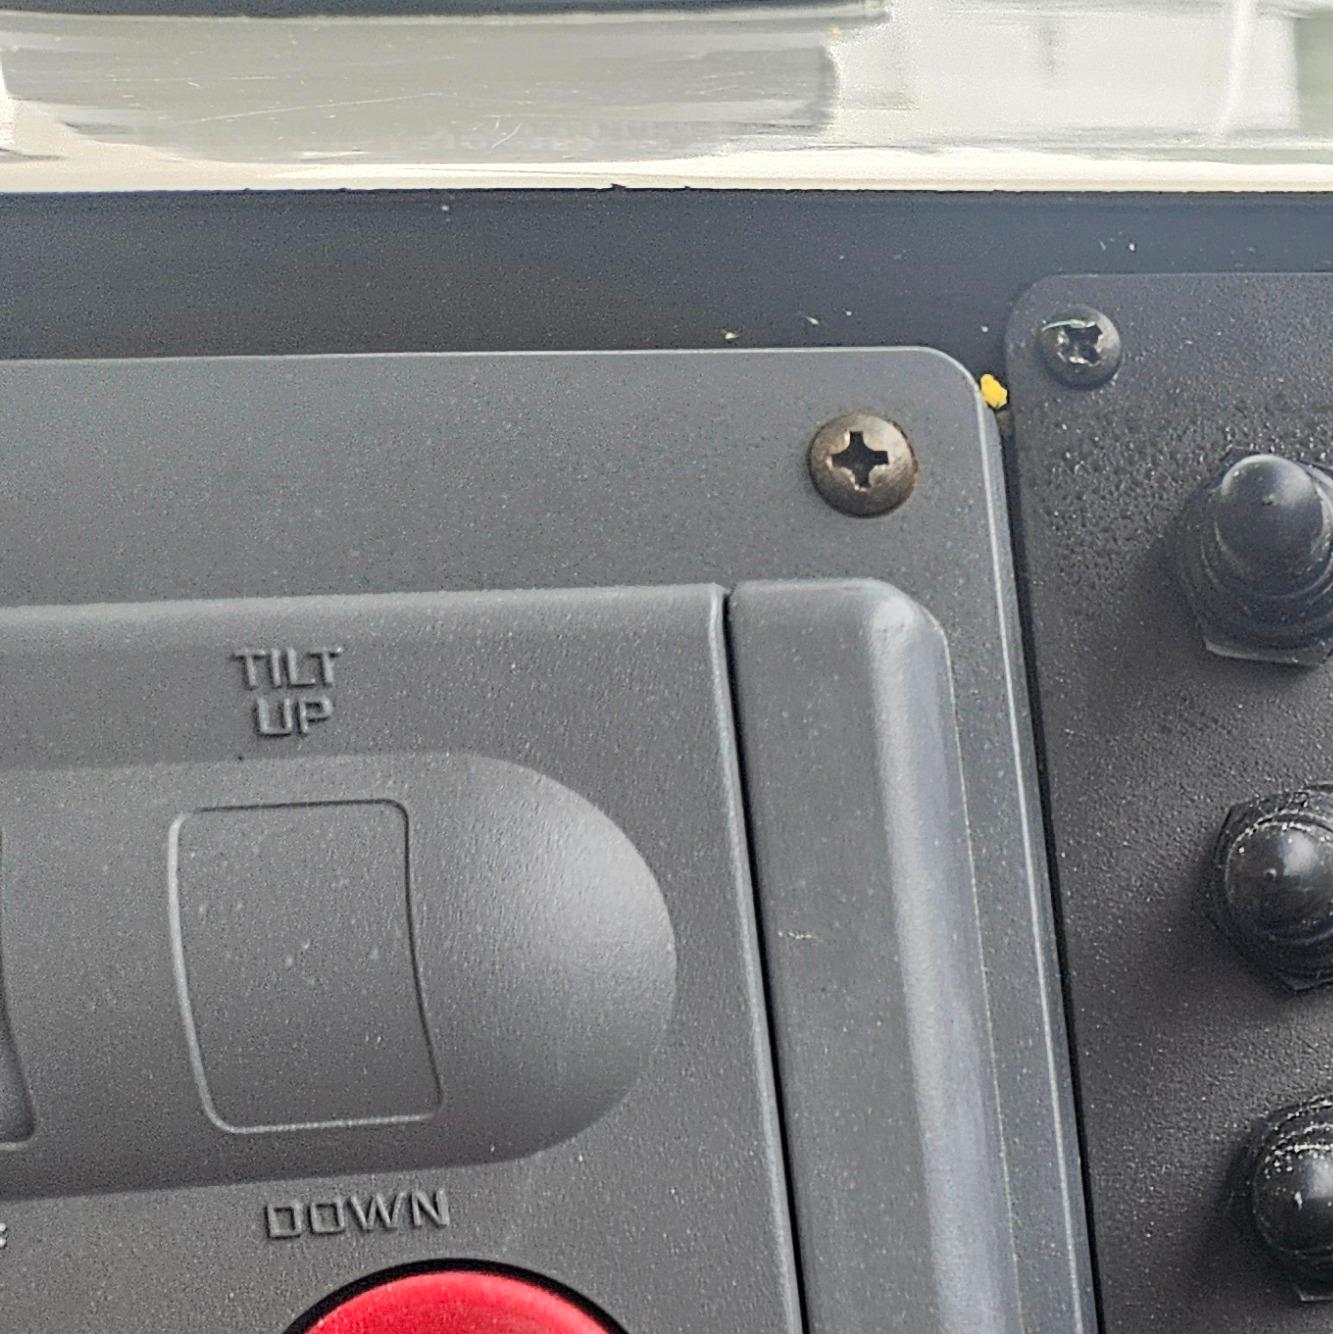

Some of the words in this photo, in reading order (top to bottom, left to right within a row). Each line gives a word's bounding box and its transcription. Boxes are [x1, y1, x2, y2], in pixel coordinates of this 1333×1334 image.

[230, 646, 342, 690] TILT
[254, 699, 334, 737] UP
[266, 1189, 451, 1238] DOWN
